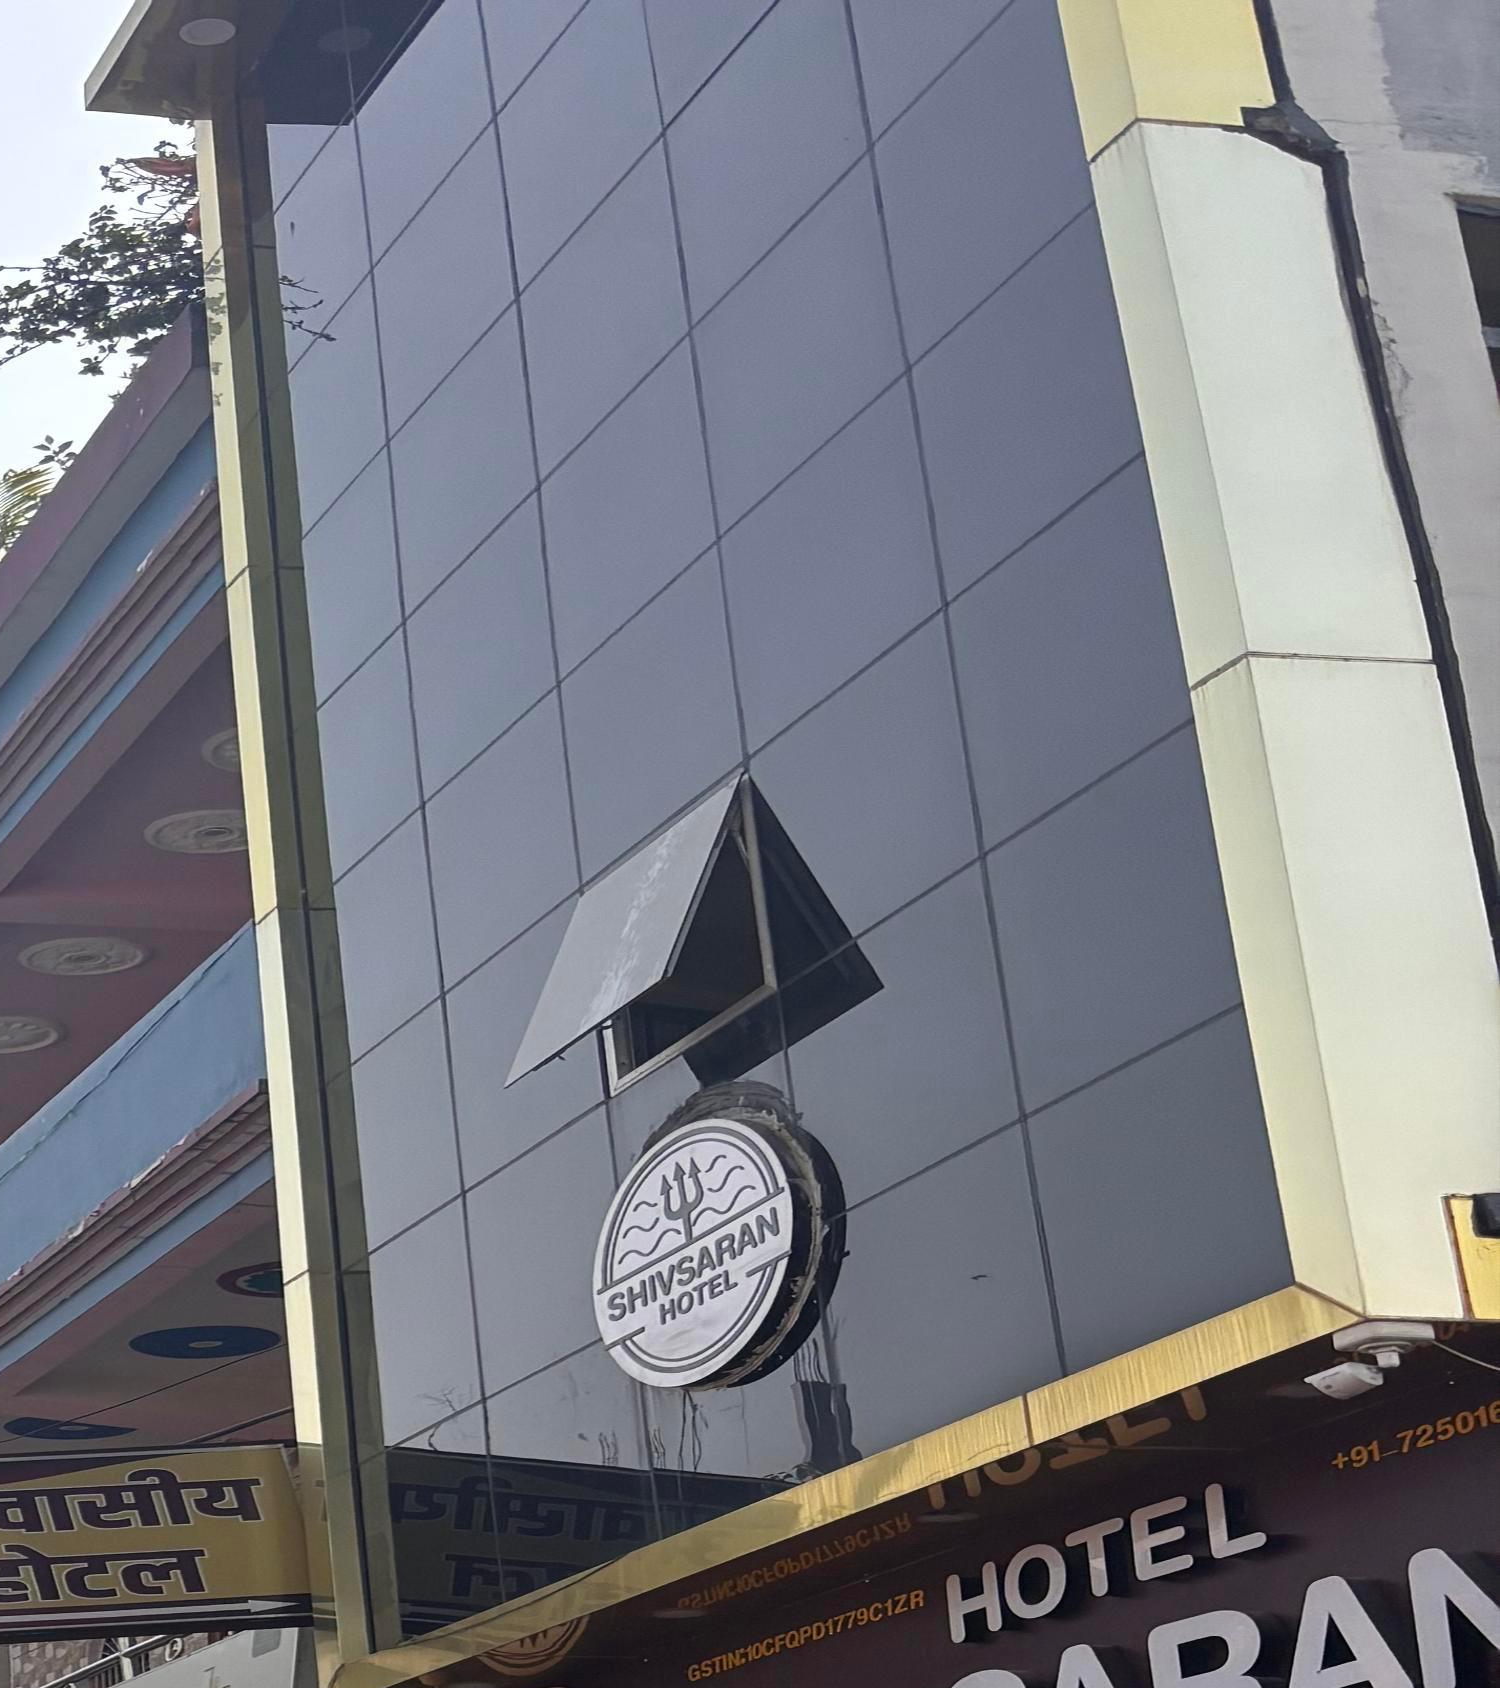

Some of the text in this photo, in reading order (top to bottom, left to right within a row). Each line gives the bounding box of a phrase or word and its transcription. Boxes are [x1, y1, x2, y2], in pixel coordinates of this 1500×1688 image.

[607, 1206, 780, 1322] SHIVSARAN
[660, 1270, 738, 1325] HOTEL
[945, 1483, 1267, 1644] HOTEL
